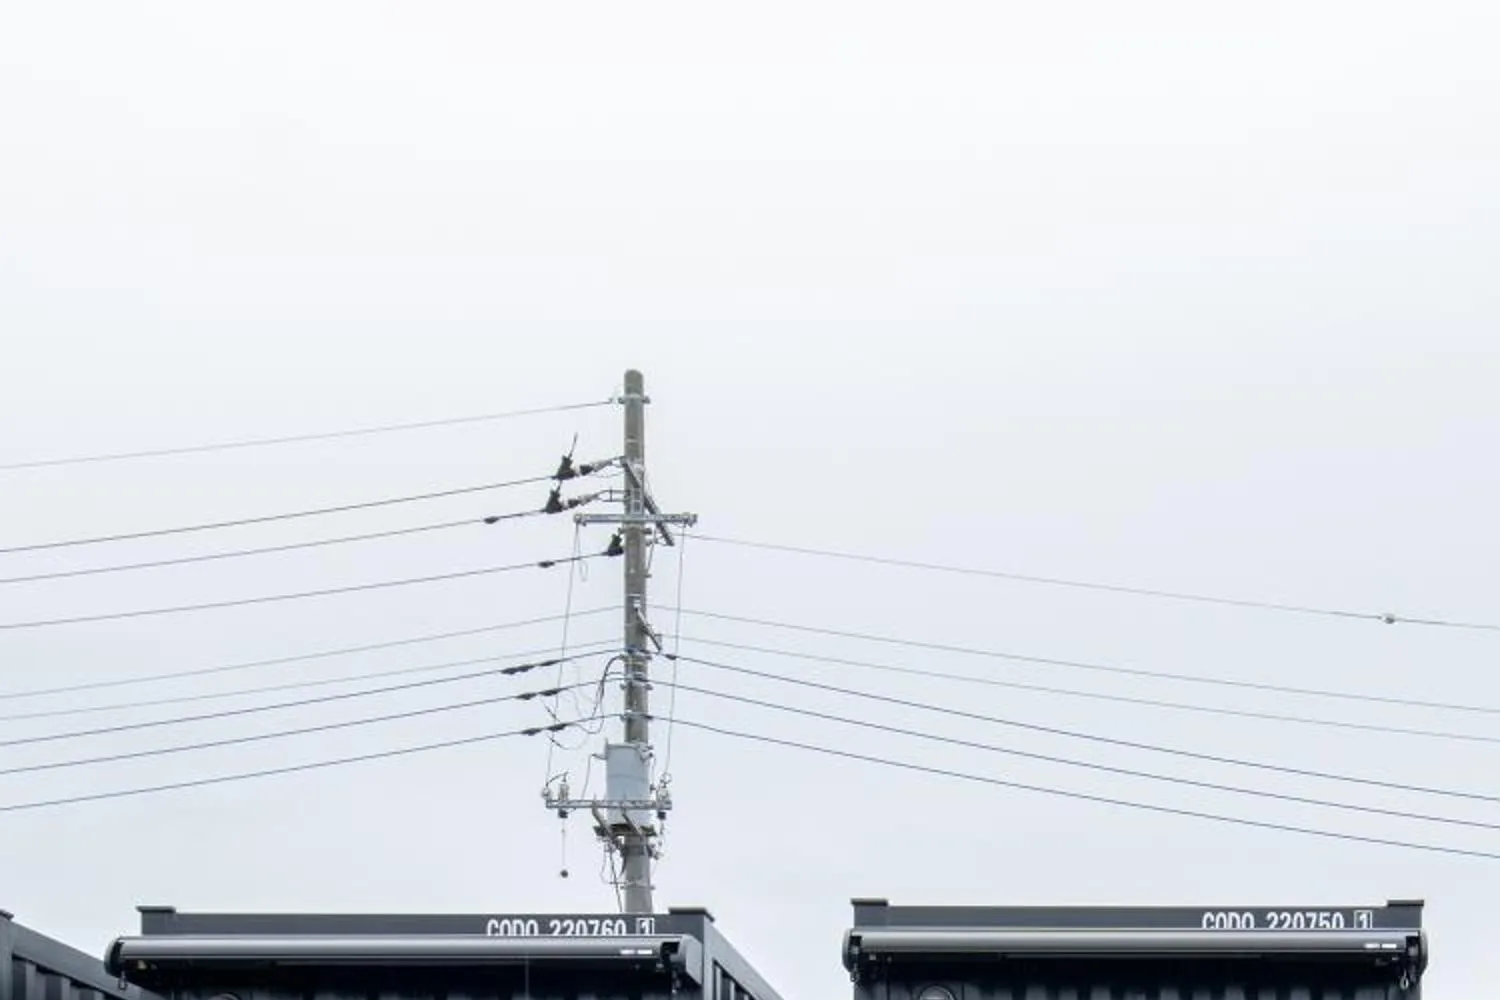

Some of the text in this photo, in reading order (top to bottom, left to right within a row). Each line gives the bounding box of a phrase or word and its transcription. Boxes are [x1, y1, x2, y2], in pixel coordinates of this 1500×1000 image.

[486, 918, 540, 936] CODO
[550, 918, 627, 936] 220760
[1202, 911, 1255, 929] CODO
[1266, 911, 1345, 929] 220750
